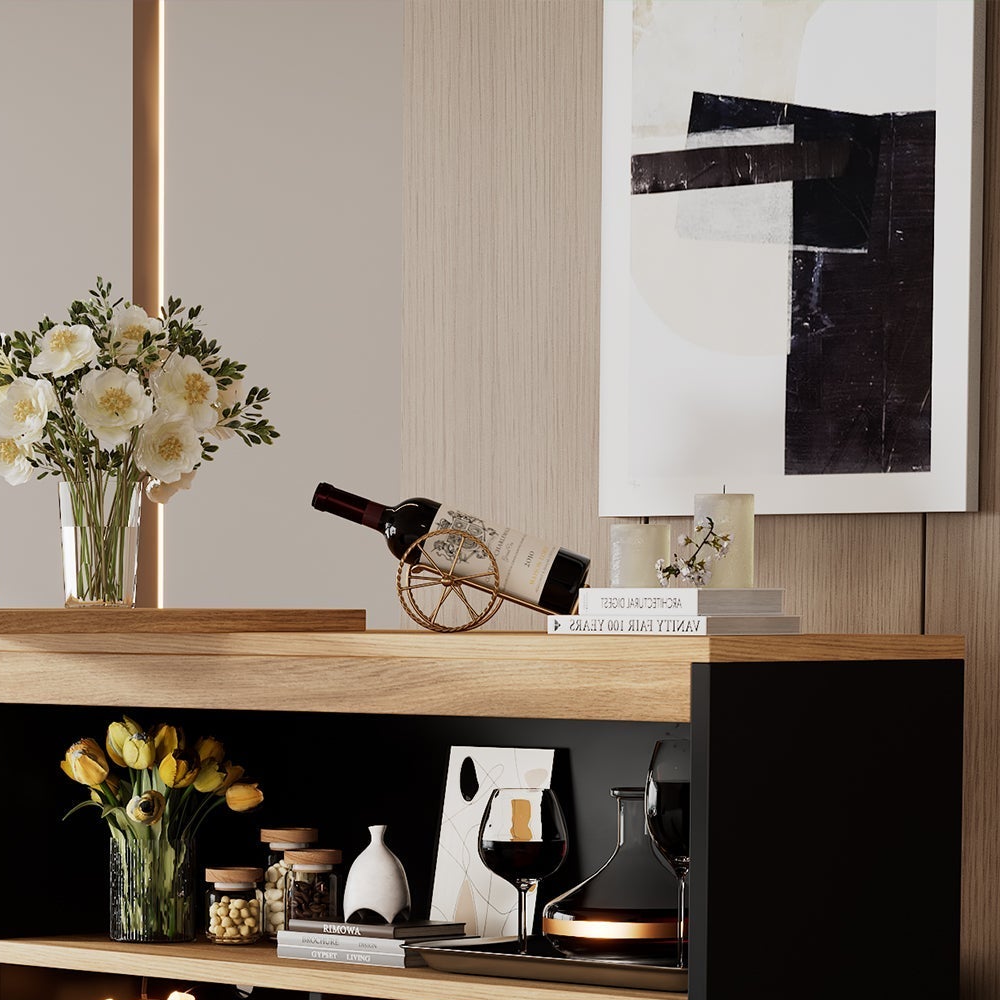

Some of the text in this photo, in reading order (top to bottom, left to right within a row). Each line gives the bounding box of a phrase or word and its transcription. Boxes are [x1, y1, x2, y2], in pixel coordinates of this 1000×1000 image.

[524, 550, 535, 568] 2010
[323, 923, 362, 936] RIMOWA
[346, 953, 371, 962] LIVING
